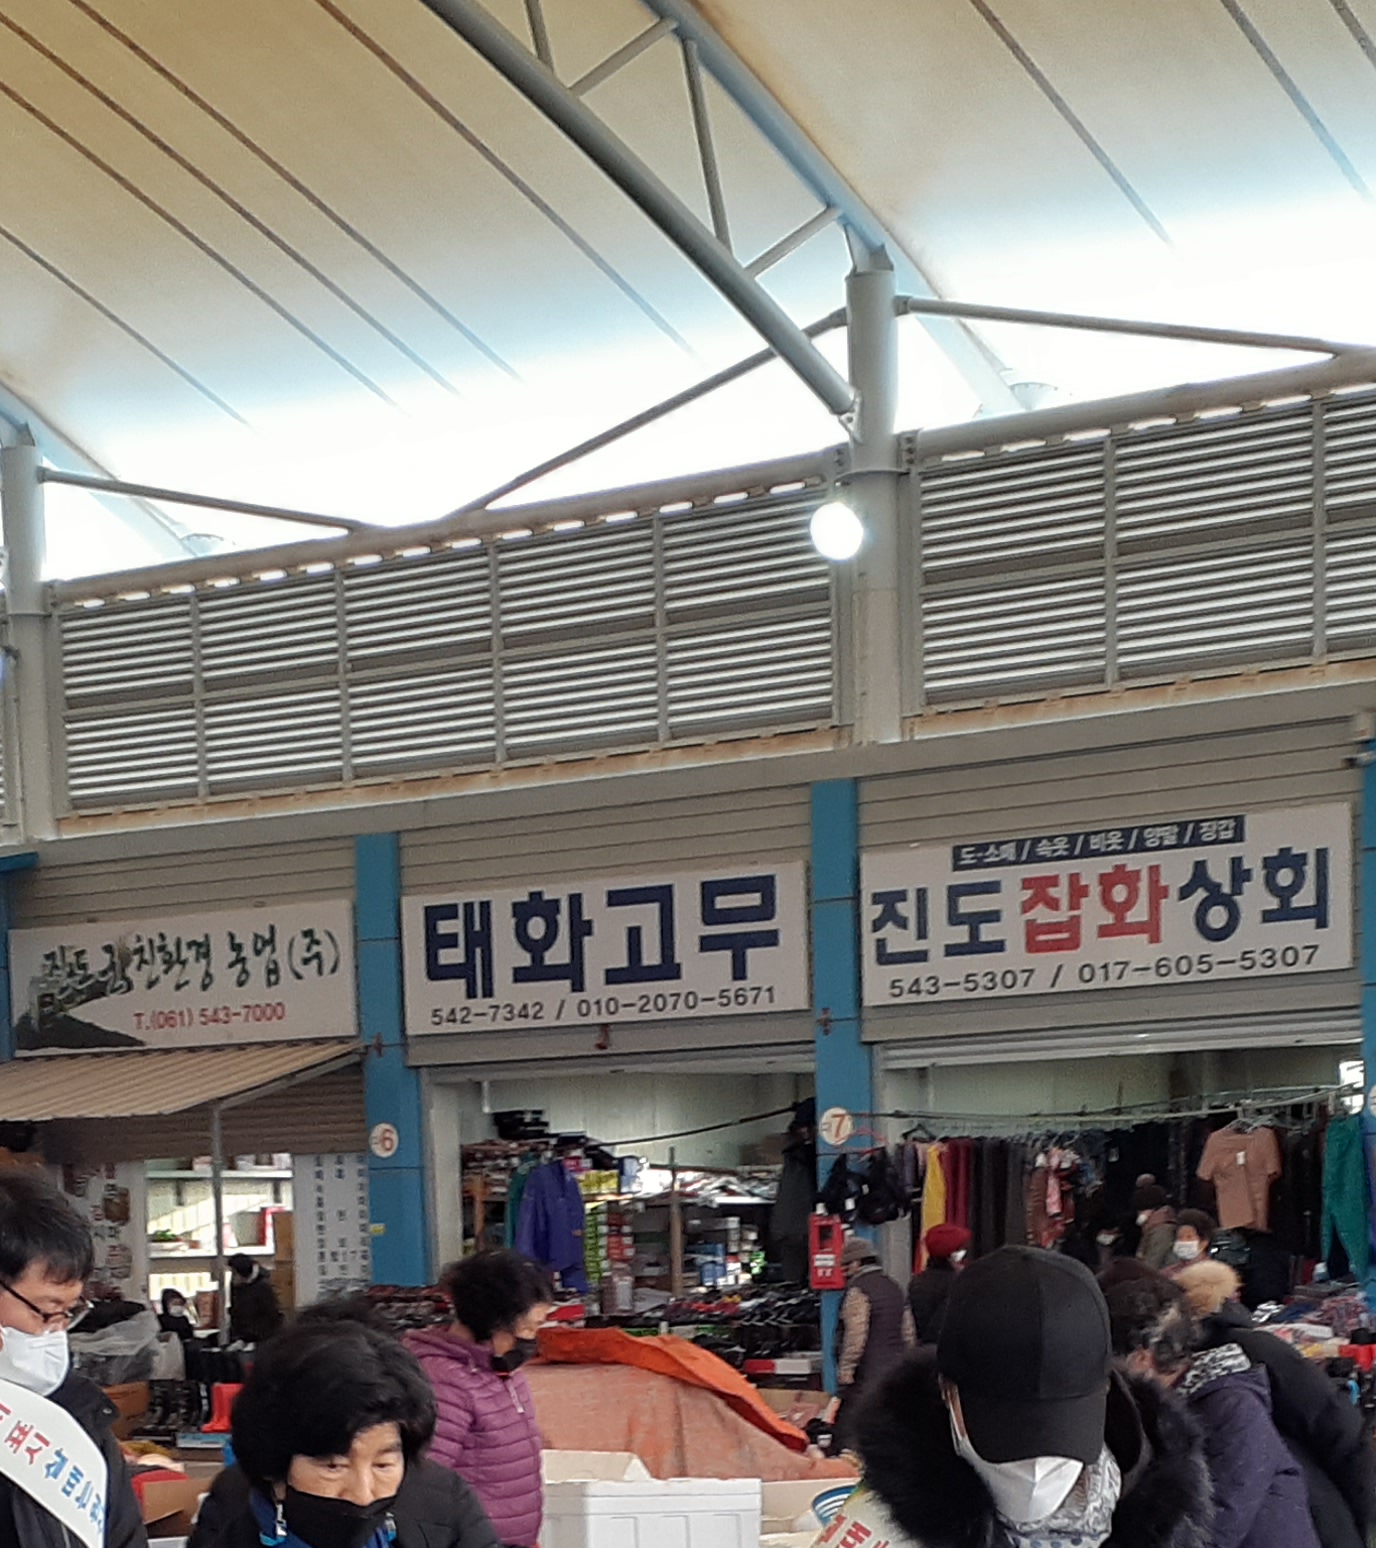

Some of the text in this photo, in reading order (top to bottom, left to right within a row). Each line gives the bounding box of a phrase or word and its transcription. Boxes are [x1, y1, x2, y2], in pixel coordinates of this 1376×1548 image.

[870, 846, 1330, 967] 진도잡화상회
[424, 874, 779, 999] 태화고무
[889, 968, 1035, 998] 543-5307
[1079, 945, 1320, 984] 017-605-5307
[199, 1002, 285, 1026] 543-7000
[431, 1001, 544, 1026] 542-7342
[577, 986, 776, 1017] 010-2070-5671
[4, 1420, 51, 1467] 표시
